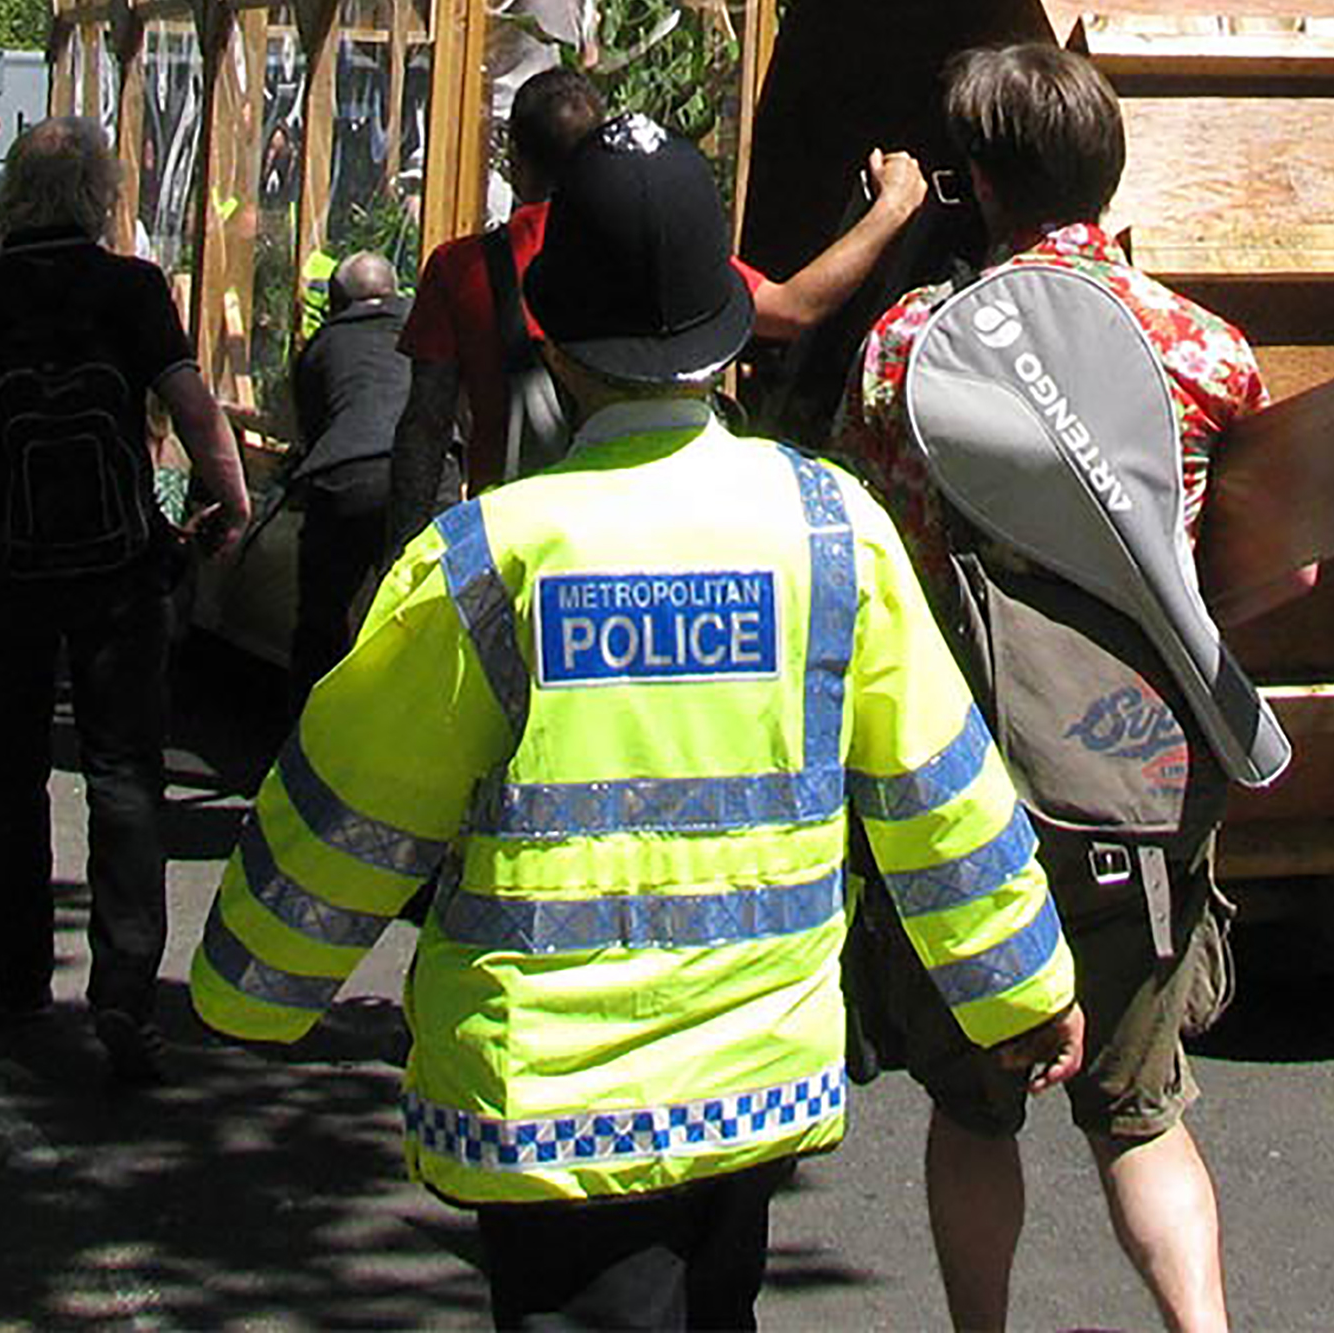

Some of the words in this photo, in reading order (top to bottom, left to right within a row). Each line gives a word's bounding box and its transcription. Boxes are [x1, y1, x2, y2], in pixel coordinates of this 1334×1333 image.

[1014, 352, 1132, 510] ARTENGO
[560, 579, 760, 608] METROPOLITAN
[563, 612, 761, 669] POLICE
